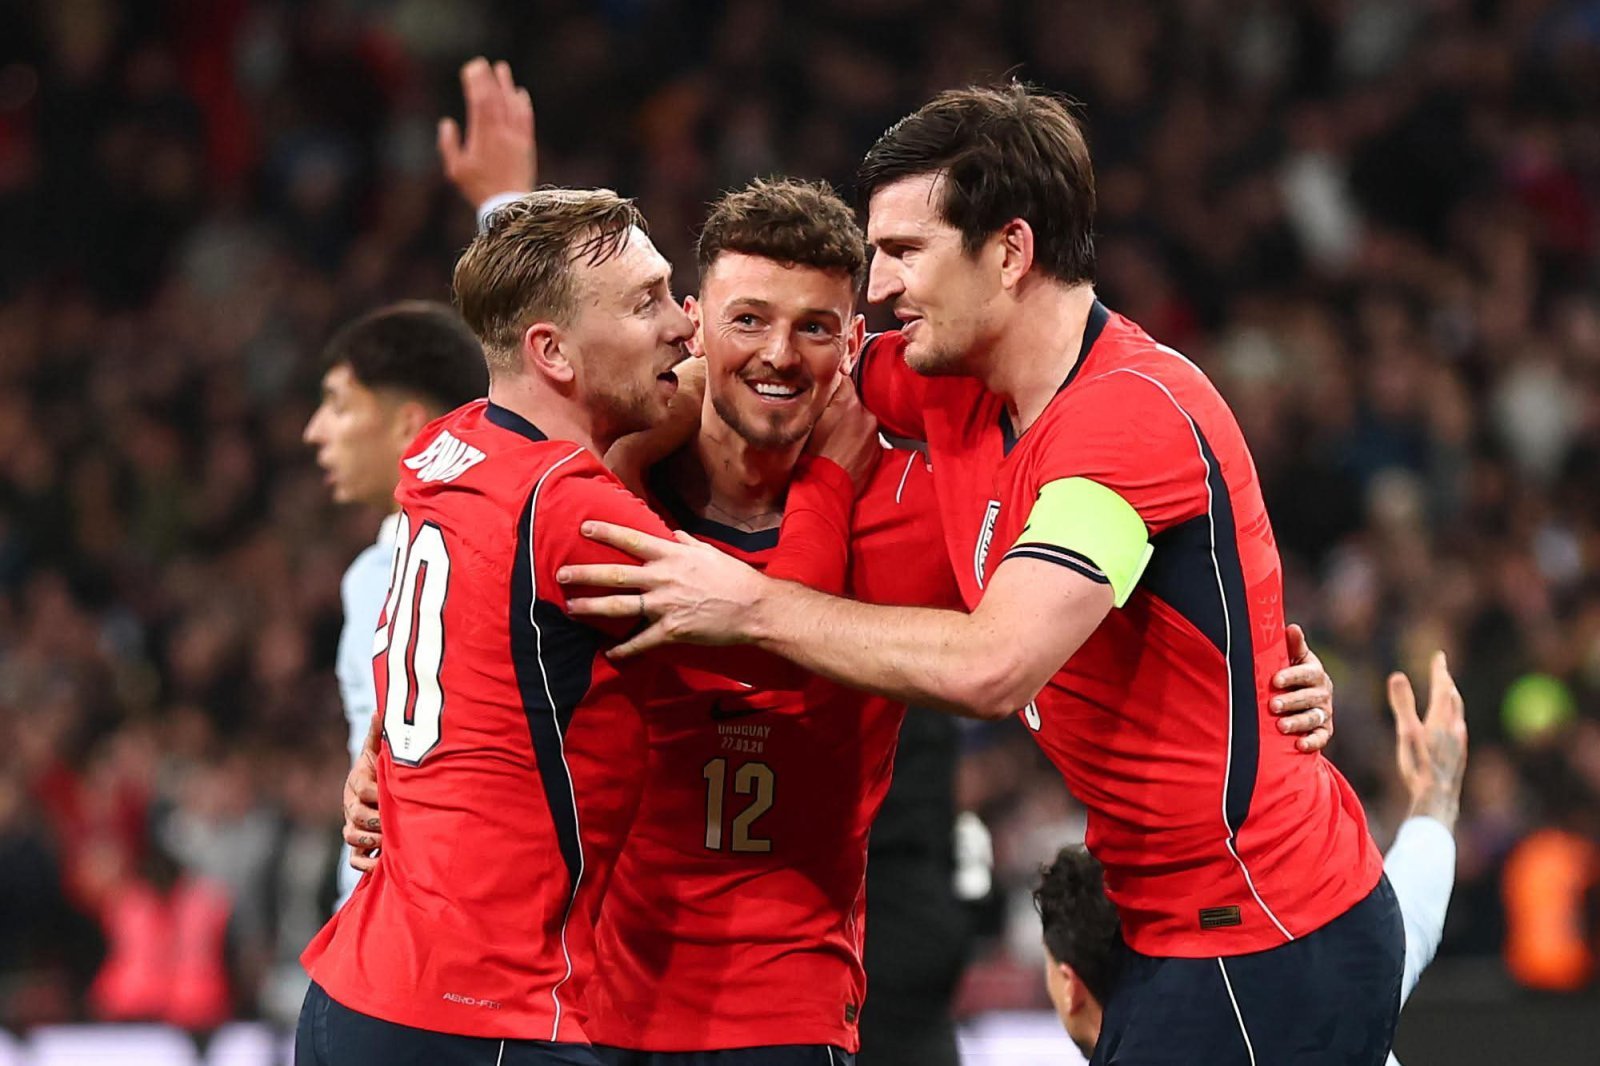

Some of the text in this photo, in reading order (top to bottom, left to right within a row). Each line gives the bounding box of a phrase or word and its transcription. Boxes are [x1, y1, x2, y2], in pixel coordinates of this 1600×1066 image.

[373, 507, 450, 767] 20
[717, 724, 771, 739] URUGUAY
[703, 757, 774, 852] 12
